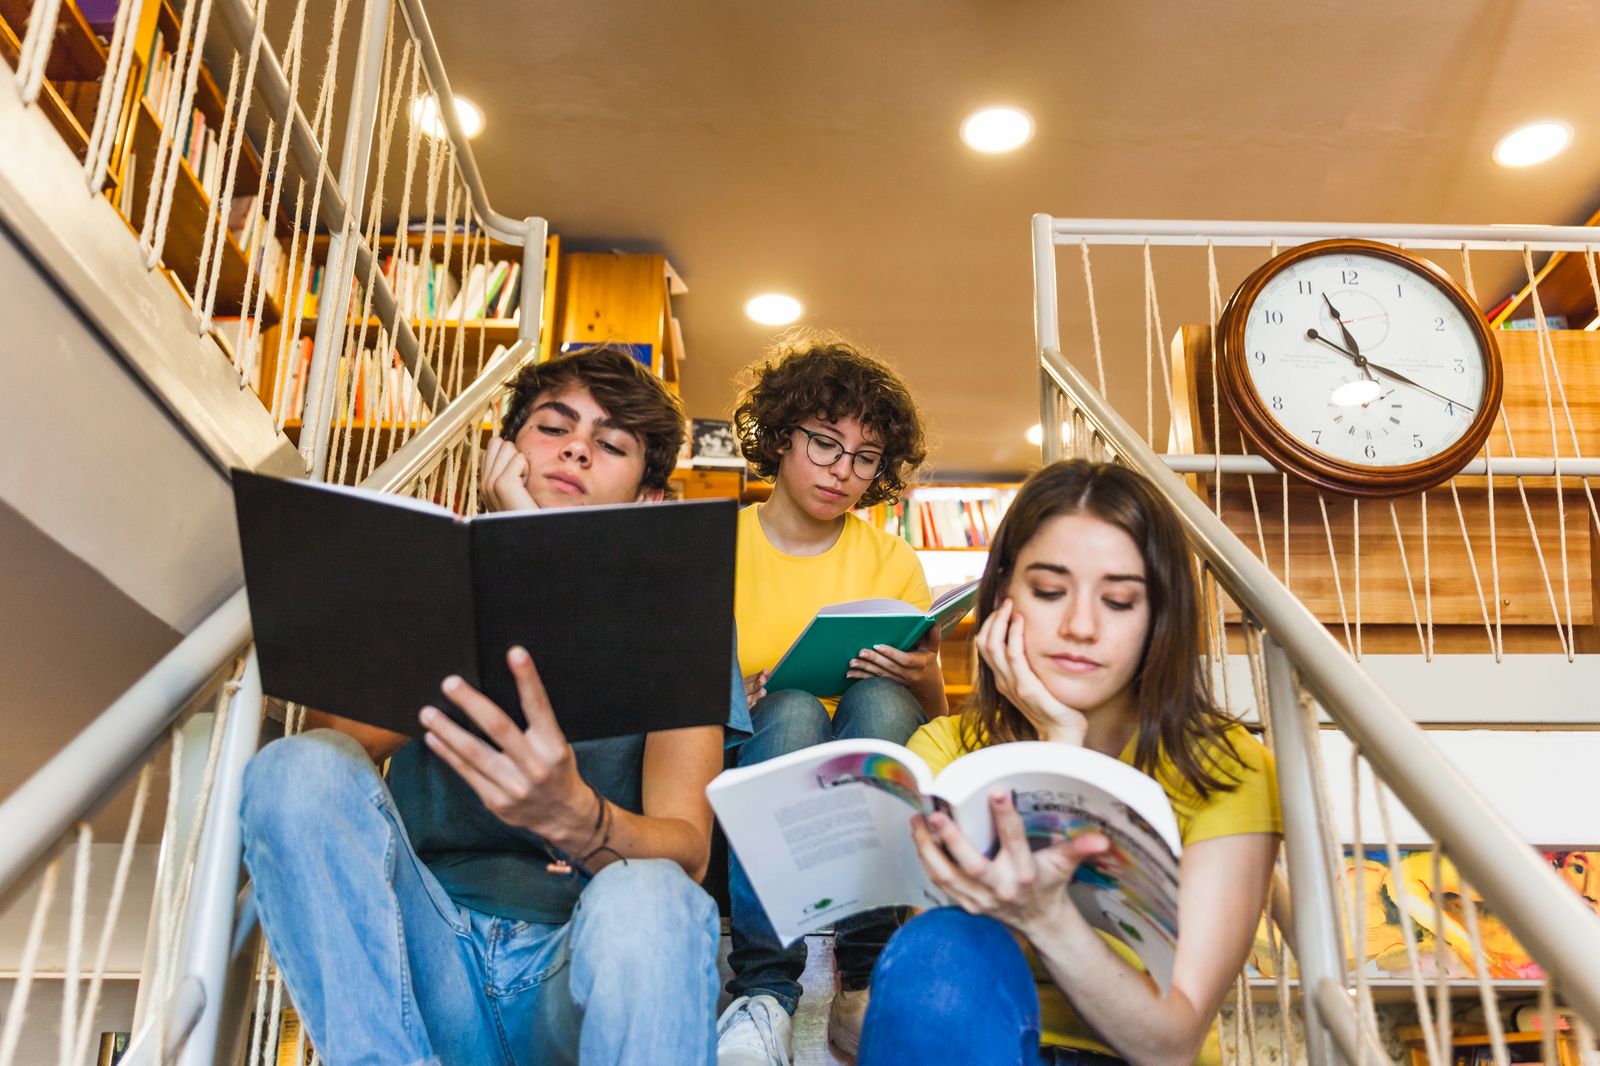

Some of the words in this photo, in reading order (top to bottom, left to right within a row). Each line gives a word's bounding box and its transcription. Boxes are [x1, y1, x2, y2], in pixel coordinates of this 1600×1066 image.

[1341, 271, 1359, 286] 12
[1299, 281, 1312, 295] 11
[1265, 310, 1283, 325] 10
[1434, 318, 1445, 332] 2
[1255, 351, 1266, 365] 9
[1454, 359, 1465, 373] 3
[1272, 396, 1284, 410] 8
[1444, 401, 1455, 416] 4
[1312, 430, 1322, 445] 7
[1413, 434, 1424, 448] 5
[1365, 445, 1376, 459] 6
